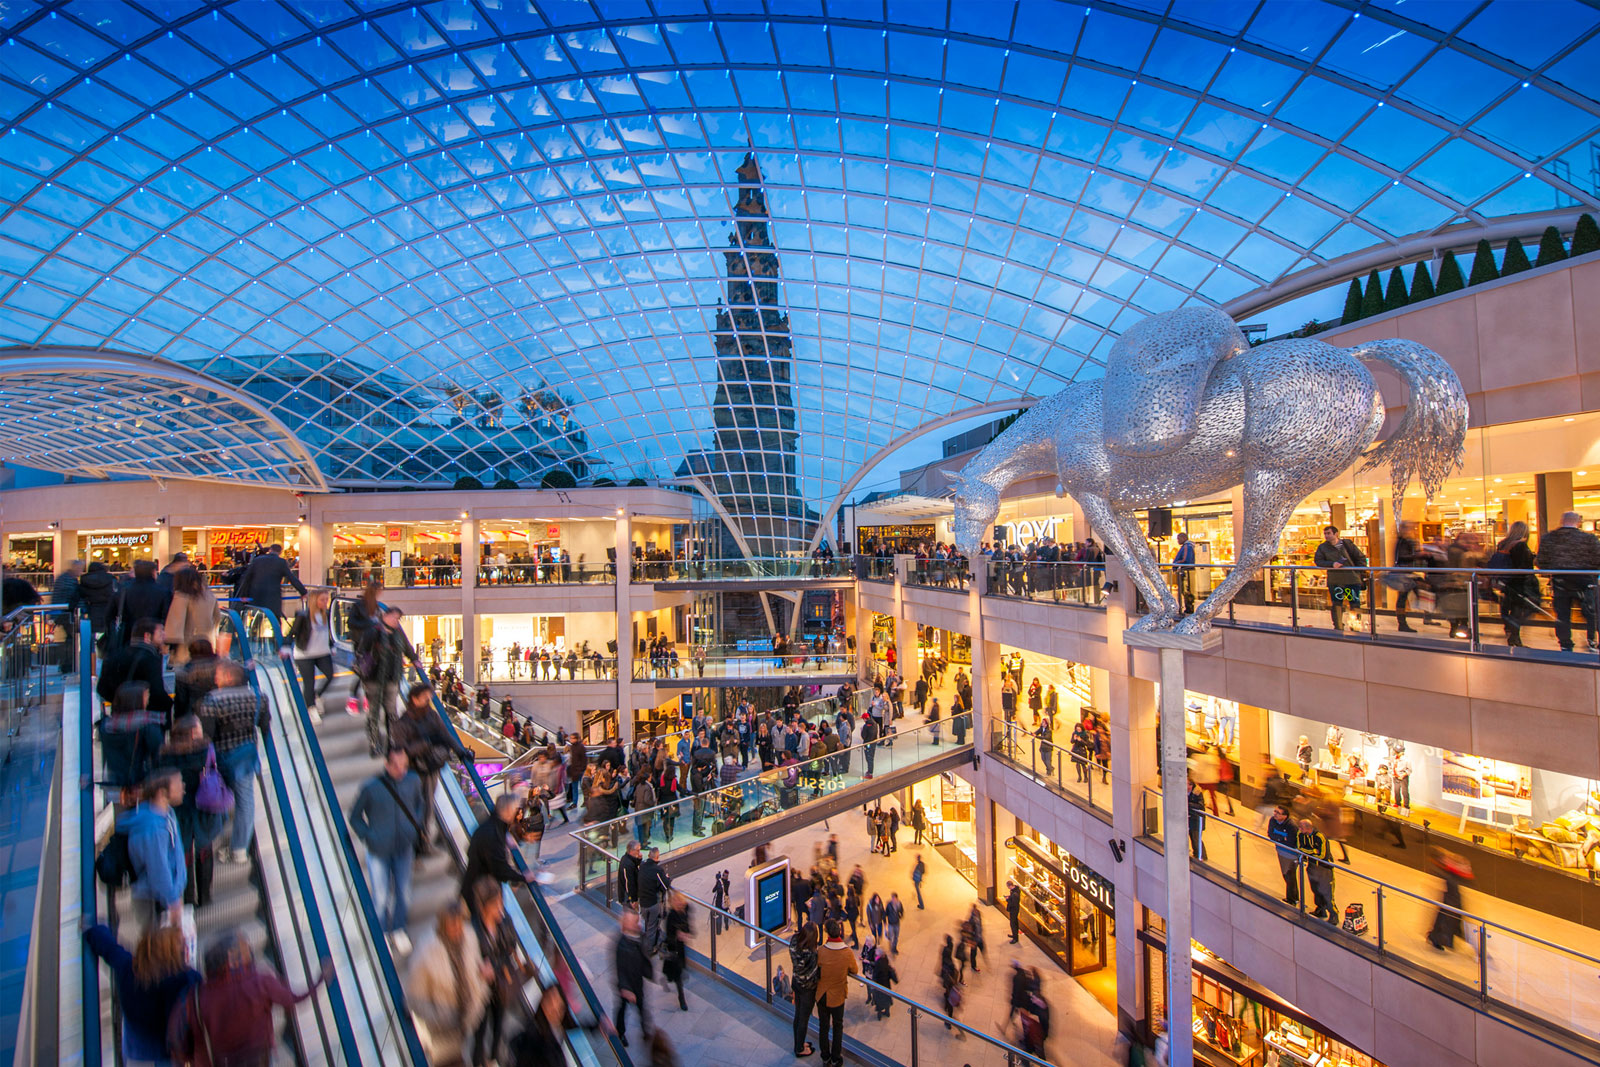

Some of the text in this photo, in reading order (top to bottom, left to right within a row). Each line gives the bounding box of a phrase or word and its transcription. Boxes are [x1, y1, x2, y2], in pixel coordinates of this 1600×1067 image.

[91, 535, 118, 545] handmade
[118, 534, 139, 546] burger
[1002, 517, 1064, 551] next
[1062, 860, 1114, 910] FOSSIL
